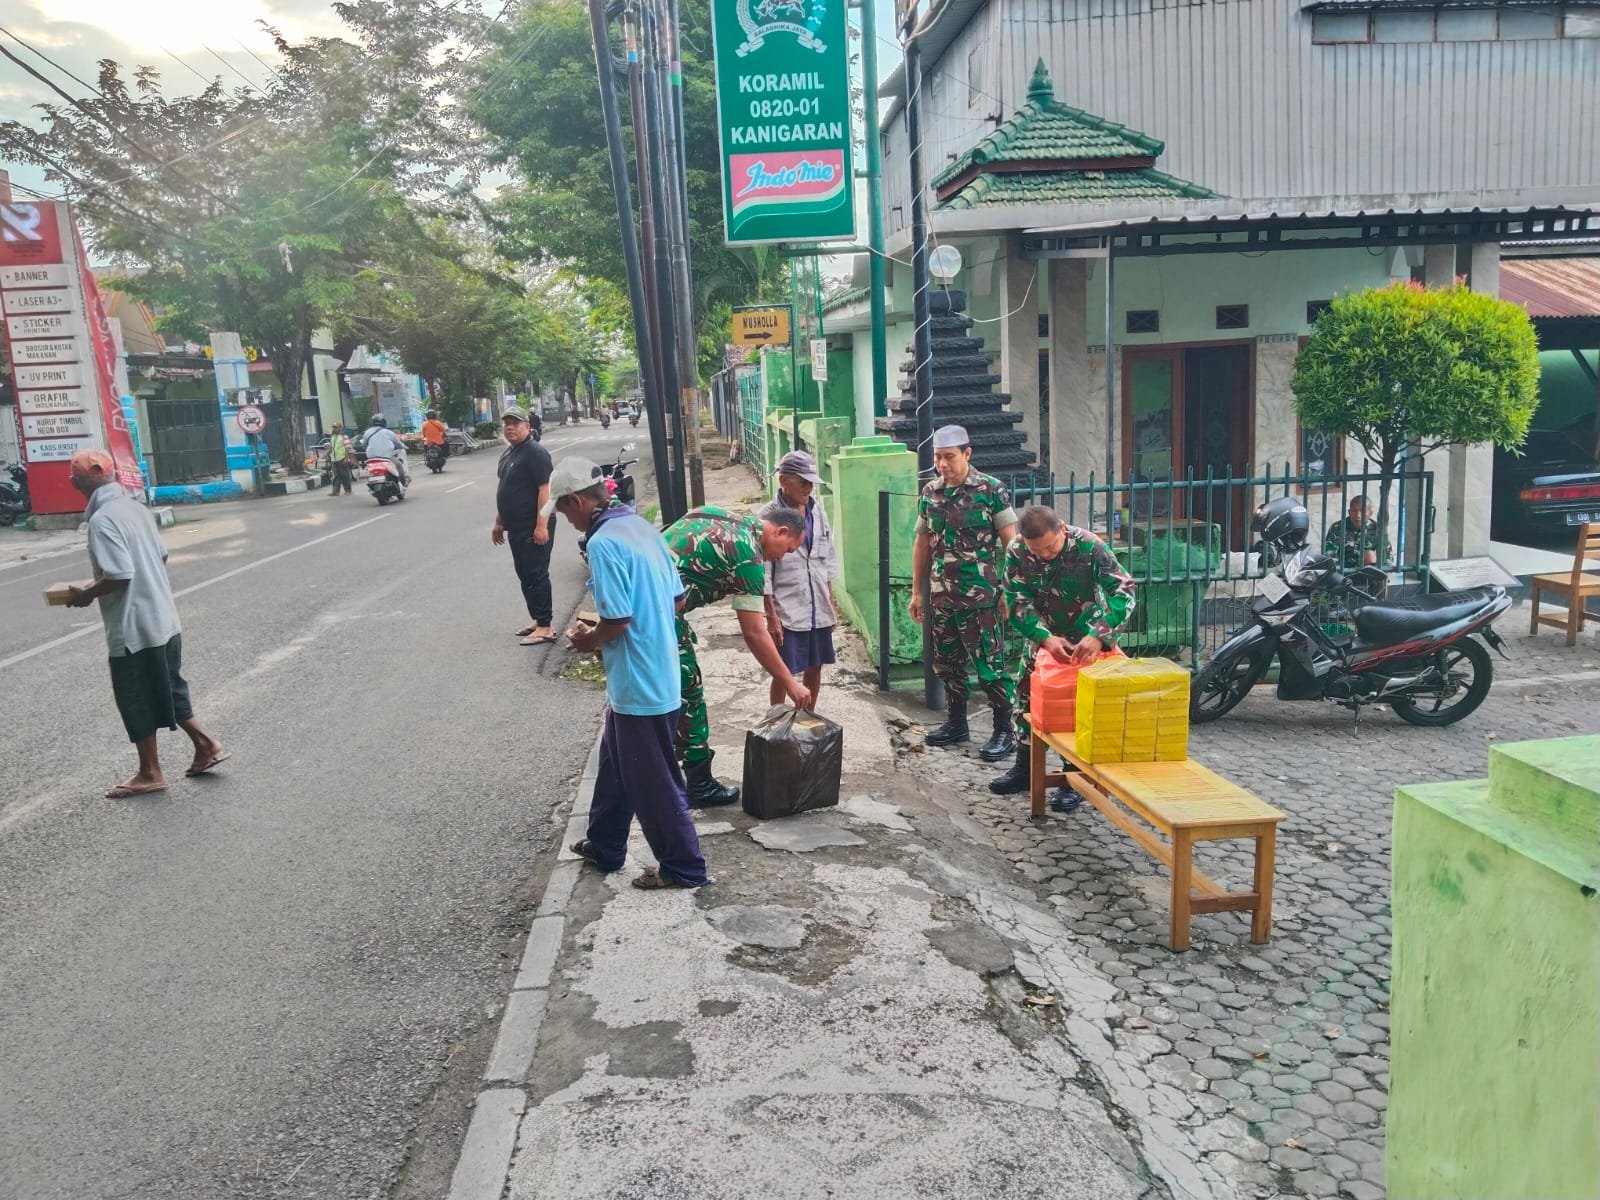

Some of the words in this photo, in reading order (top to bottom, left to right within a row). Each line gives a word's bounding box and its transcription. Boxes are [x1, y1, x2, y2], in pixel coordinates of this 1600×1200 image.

[739, 72, 825, 93] KORAMIL
[750, 97, 819, 118] 0820-01
[731, 122, 843, 144] KANIGARAN
[14, 270, 49, 281] BANNER
[18, 296, 45, 306] LASER
[23, 318, 62, 328] STICKER
[743, 316, 778, 328] MUSHOLLA
[30, 371, 41, 381] UV
[42, 370, 66, 380] PRINT
[33, 393, 68, 402] GRAFIR
[59, 416, 83, 425] TIMBUL
[56, 425, 69, 433] BOX
